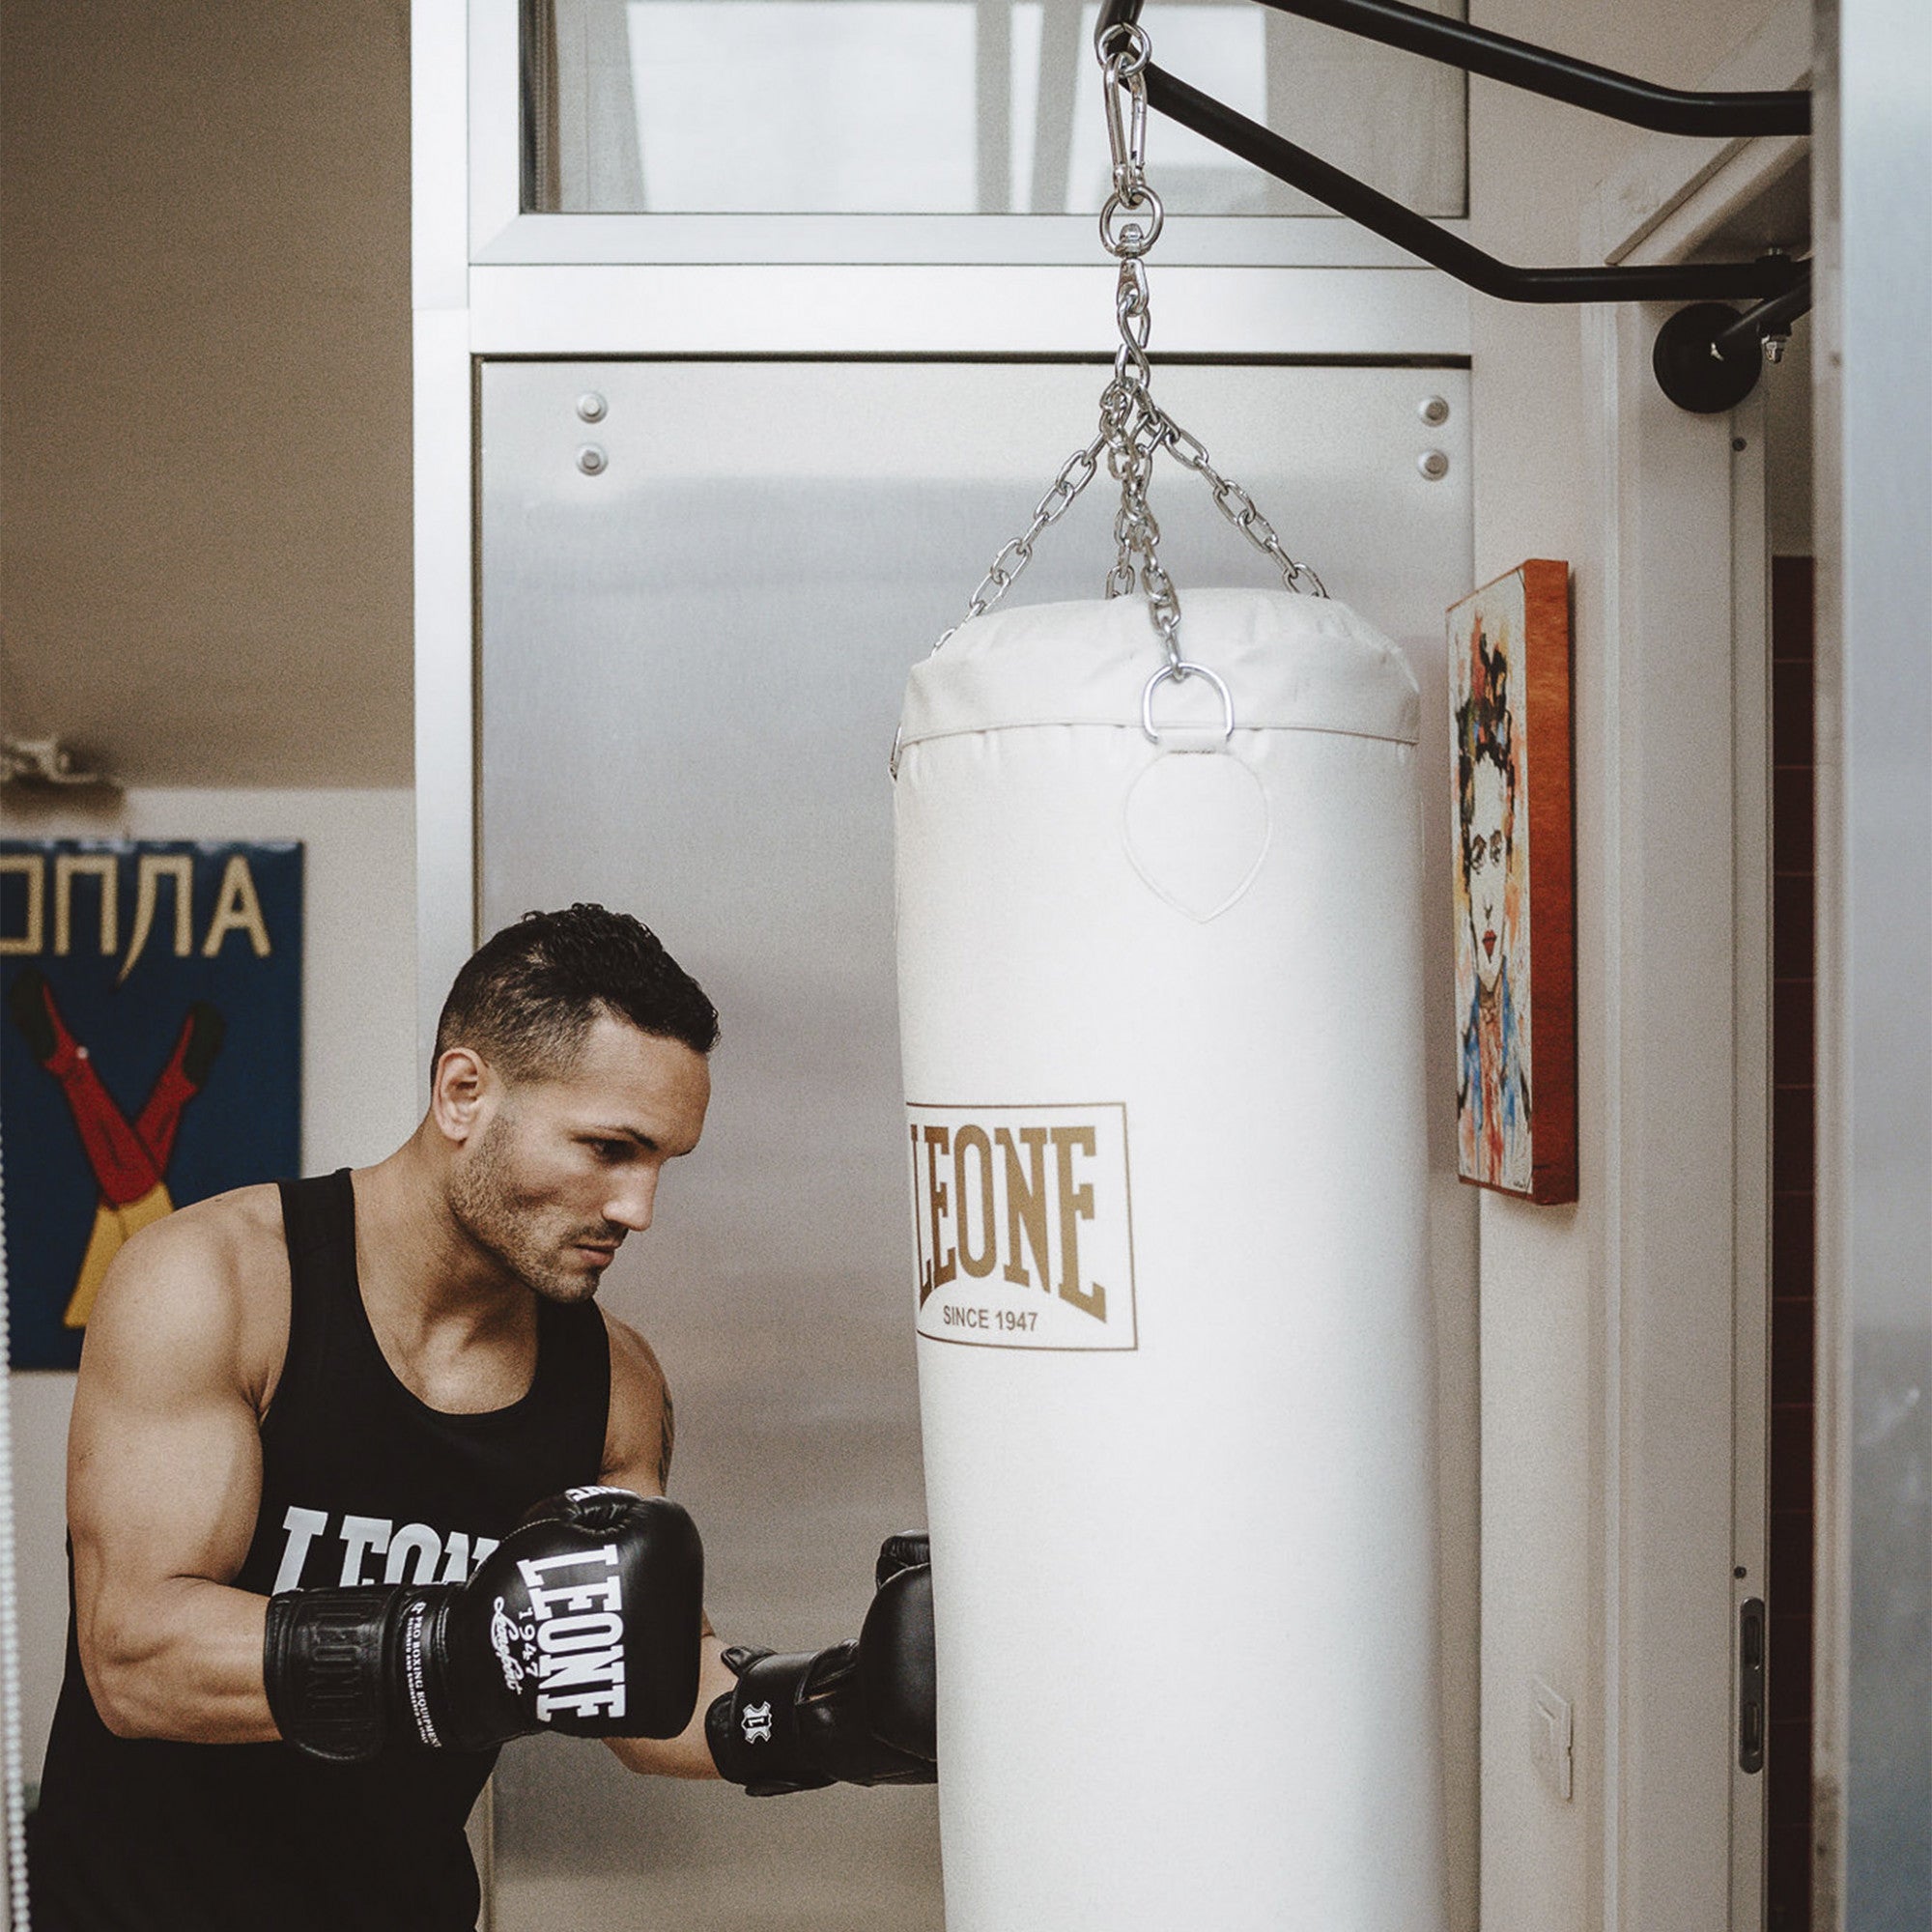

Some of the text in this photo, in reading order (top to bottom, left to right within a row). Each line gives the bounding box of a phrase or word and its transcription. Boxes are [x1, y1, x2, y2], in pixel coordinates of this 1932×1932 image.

[943, 1305, 1038, 1332] SINCE 1947
[412, 1615, 442, 1748] PRO BOXING EQUIPMENT
[517, 1544, 626, 1722] LEONE
[519, 1605, 539, 1678] 1947
